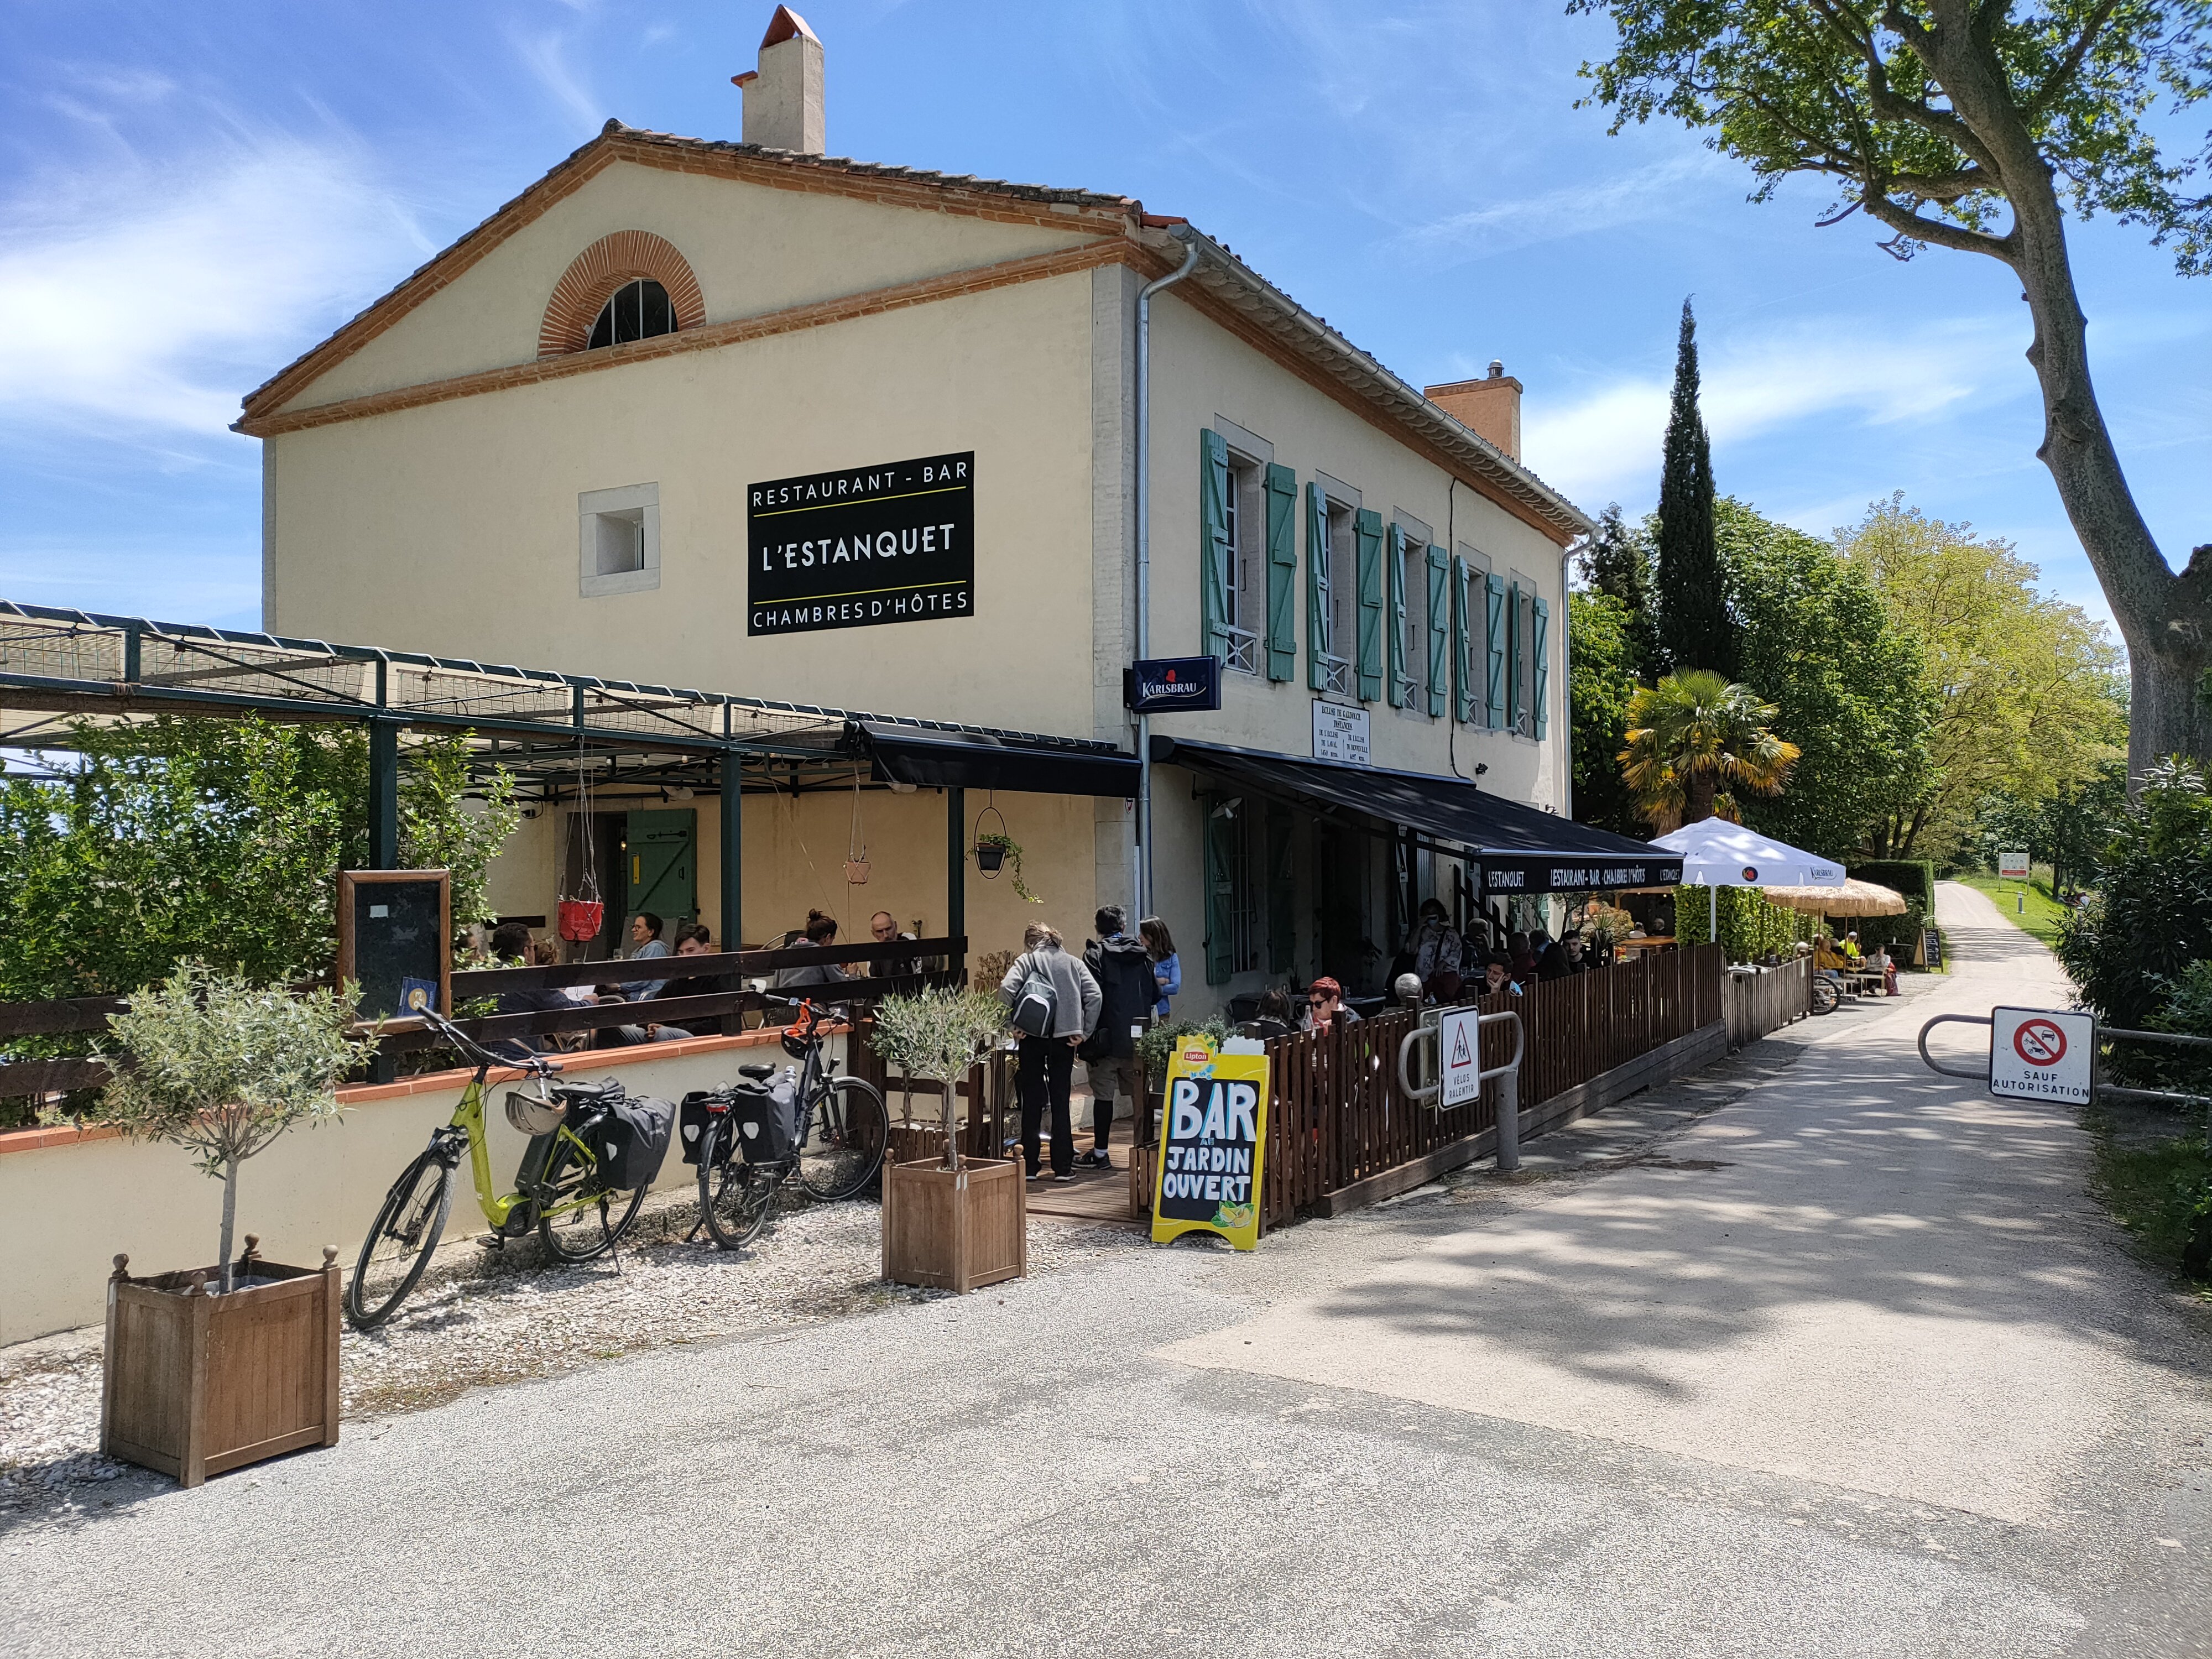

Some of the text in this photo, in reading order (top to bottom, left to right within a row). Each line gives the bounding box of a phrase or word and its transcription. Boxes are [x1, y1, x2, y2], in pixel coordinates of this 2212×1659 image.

[753, 472, 895, 507] RESTAURANT
[924, 462, 967, 483] BAR
[763, 523, 954, 571] L'ESTANQUET
[753, 592, 967, 627] CHAMBRES D'HÔTES
[1142, 682, 1196, 698] KARLSBRAU
[1488, 871, 1525, 887] L'ESTANQUET
[1550, 869, 1585, 886] ESTAURANT
[1589, 869, 1600, 885] BAR
[1453, 1073, 1470, 1086] VÉLOS
[2024, 1071, 2058, 1082] SAUF
[1449, 1084, 1474, 1099] RALENTIR
[1993, 1079, 2089, 1098] AUTORISATION
[1171, 1080, 1257, 1142] BAR
[1167, 1146, 1250, 1174] JARDIN
[1163, 1172, 1251, 1202] OUVERT
